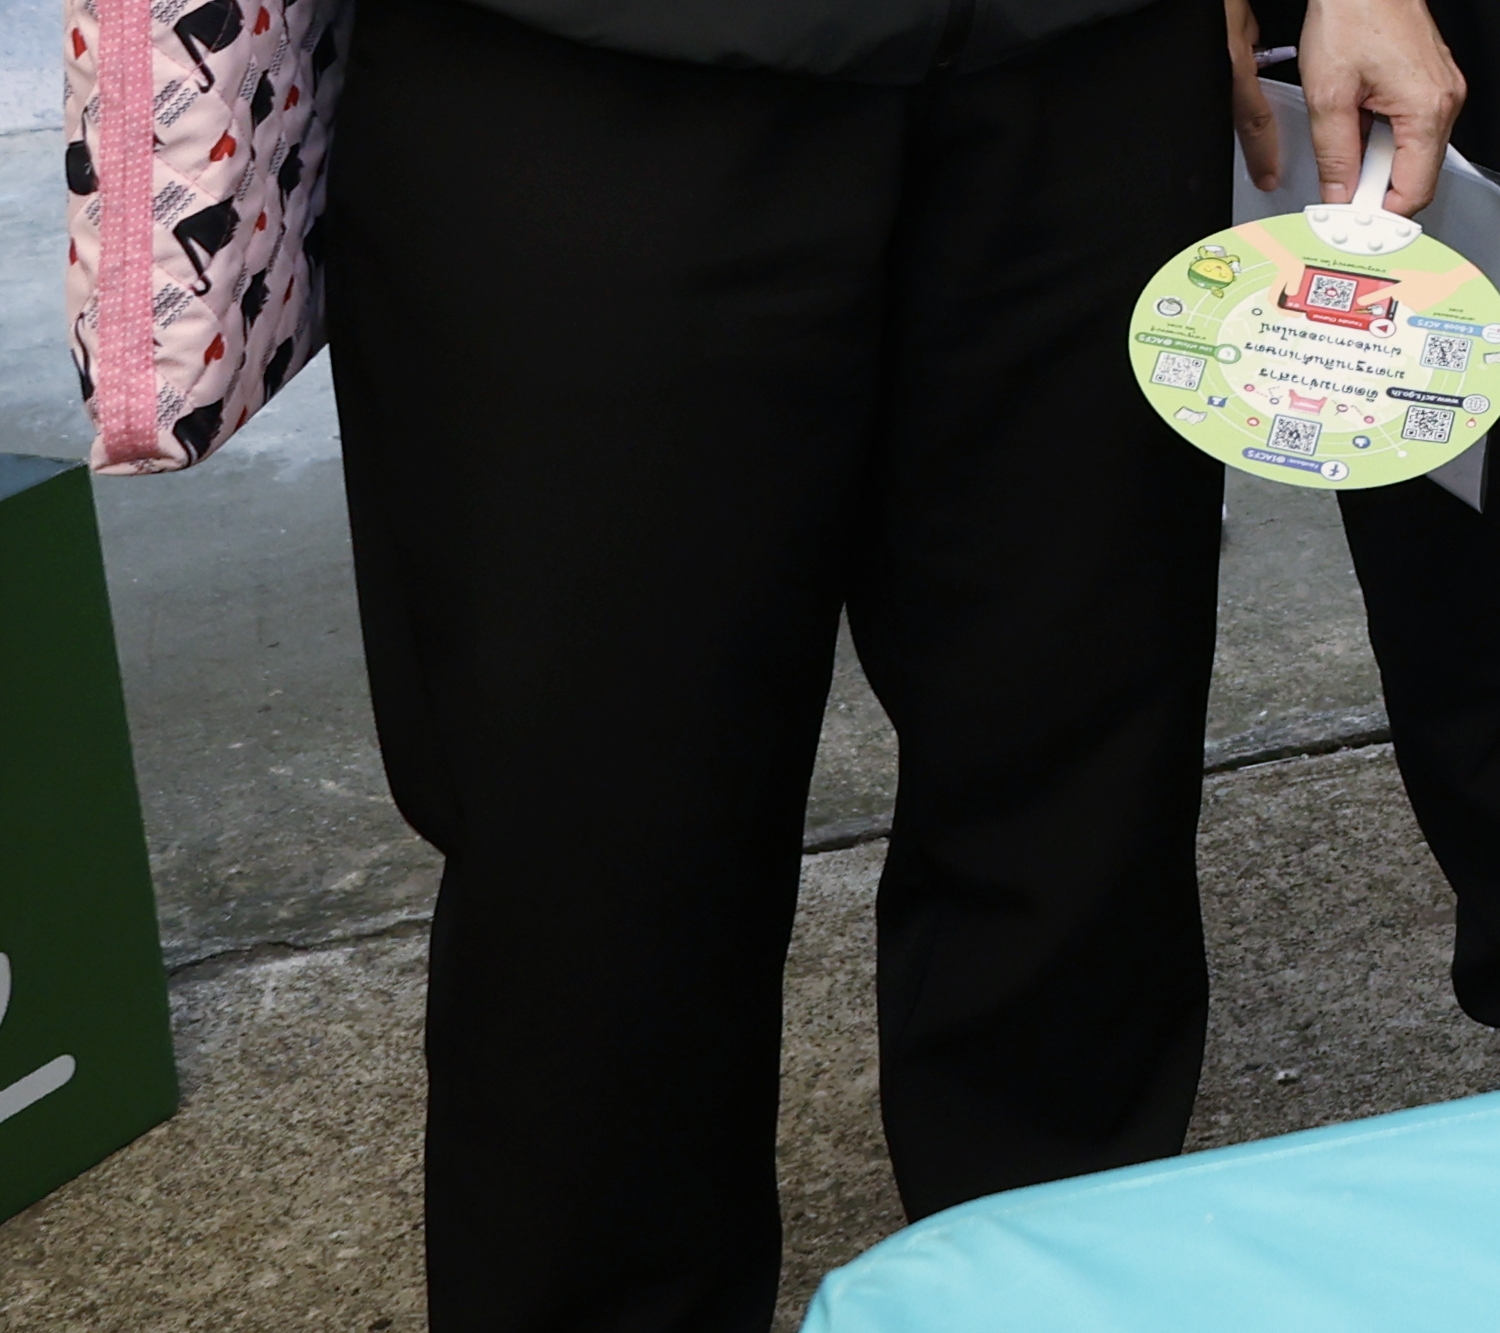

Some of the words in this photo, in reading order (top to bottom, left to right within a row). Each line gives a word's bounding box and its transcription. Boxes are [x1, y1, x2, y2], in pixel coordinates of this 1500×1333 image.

[1258, 322, 1401, 357] ผ่านช่องทางออนไลน์
[1416, 317, 1440, 329] ACFS
[1244, 340, 1405, 380] มาตรฐานสินค้าเกษตร
[1258, 367, 1378, 402] ติดตามข่าวสาร
